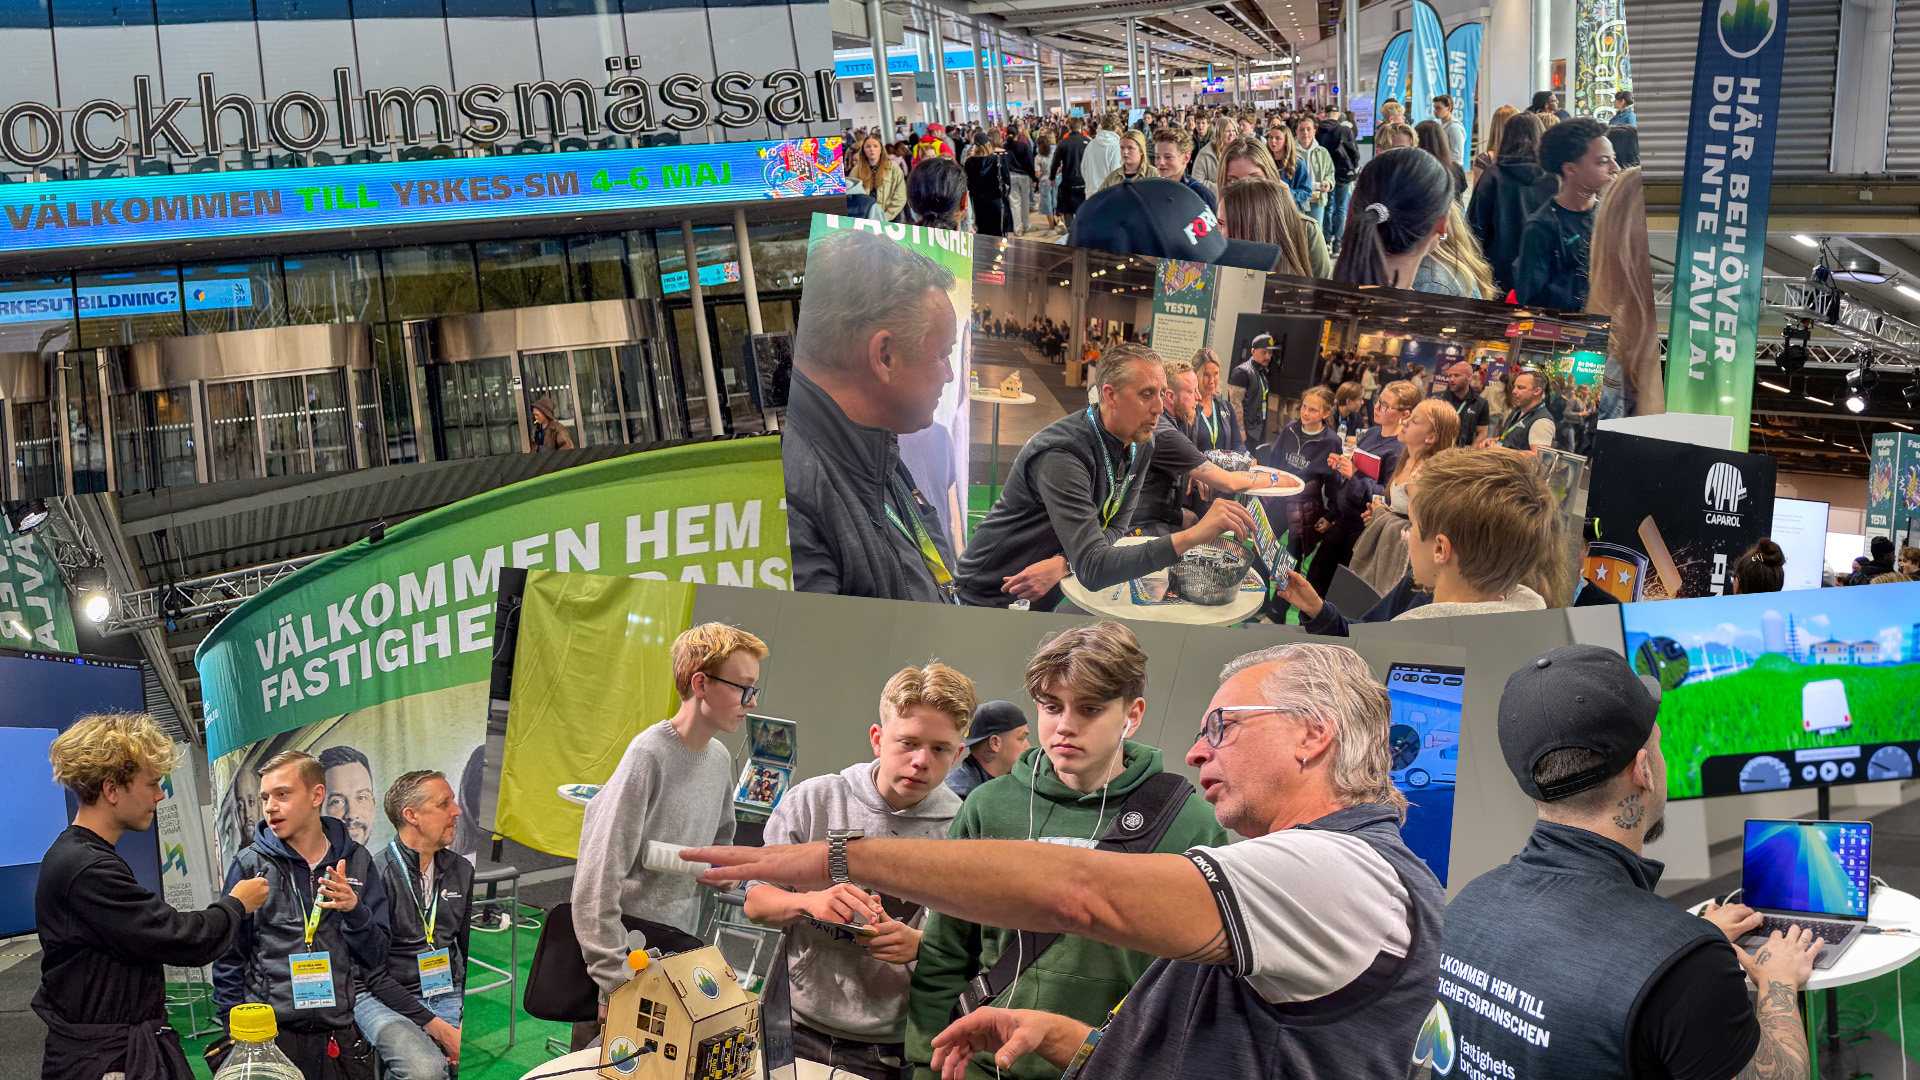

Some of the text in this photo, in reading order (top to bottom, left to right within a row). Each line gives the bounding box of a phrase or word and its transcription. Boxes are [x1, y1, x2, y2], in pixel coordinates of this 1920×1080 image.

[4, 189, 283, 231] VÄLKOMMEN
[295, 184, 379, 212] TILL
[391, 171, 580, 207] YRKES-SM
[661, 162, 732, 188] MAJ
[1714, 77, 1763, 363] HÄR BEHÖVER
[1689, 76, 1734, 380] DU INTE TÄVLA!
[1164, 302, 1198, 316] TESTA
[1705, 513, 1741, 528] CAPAROL
[255, 522, 600, 671] VÄLKOMMEN
[626, 500, 762, 564] HEM
[261, 603, 498, 714] FASTIGHE
[1191, 855, 1220, 883] DKNY
[1490, 977, 1518, 1005] HEM
[1517, 990, 1546, 1020] TILL
[1460, 1035, 1516, 1080] fastighets
